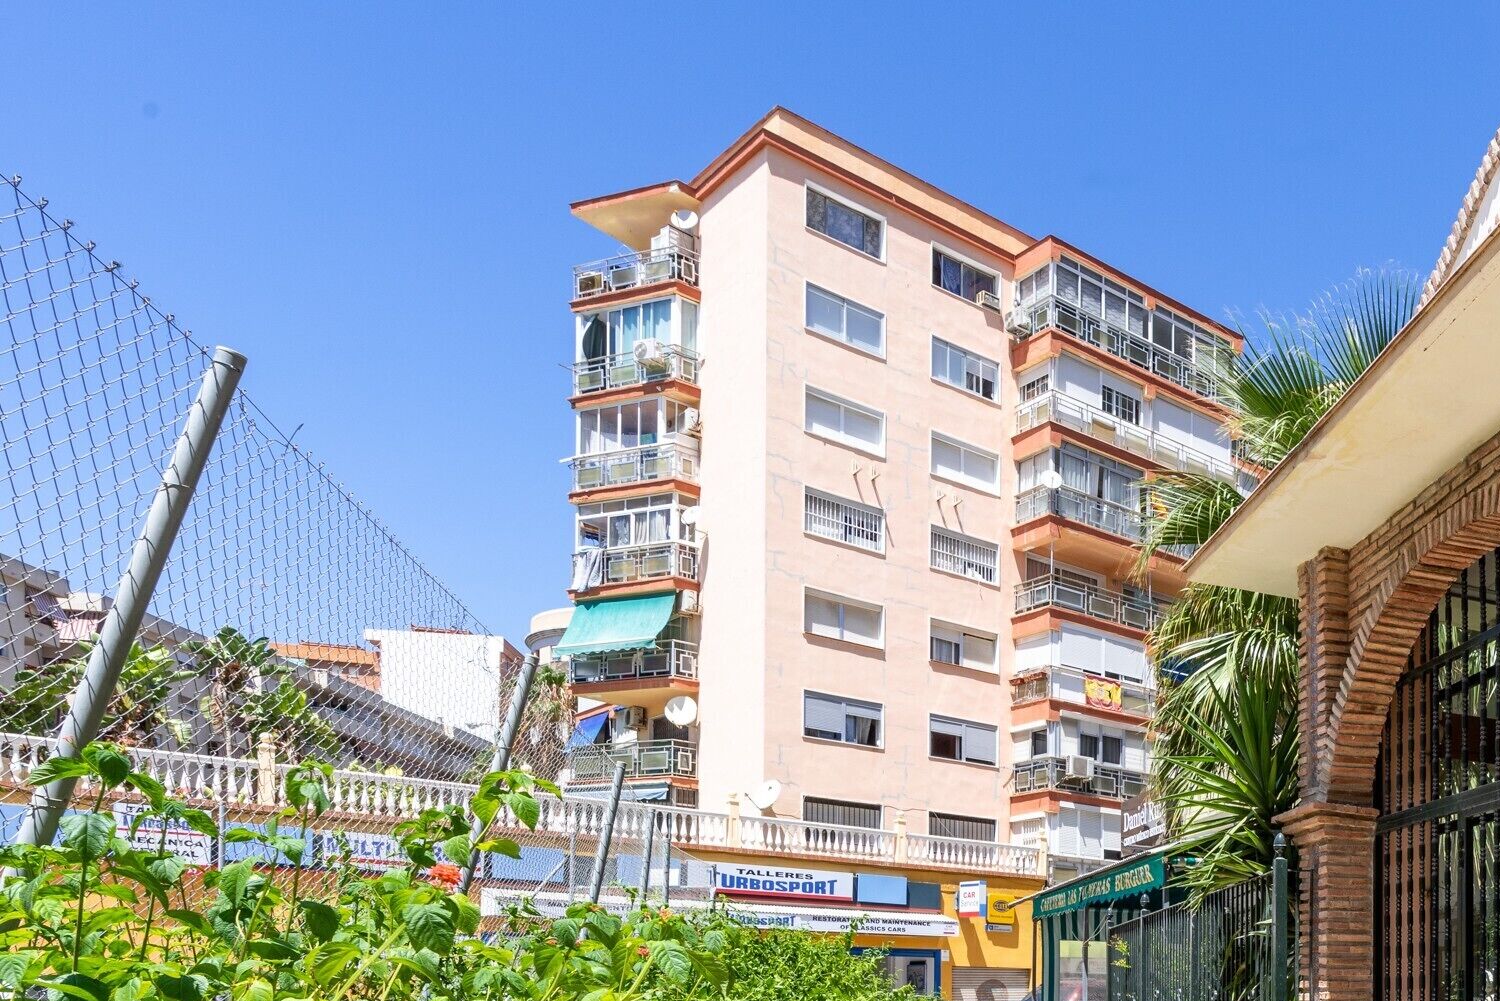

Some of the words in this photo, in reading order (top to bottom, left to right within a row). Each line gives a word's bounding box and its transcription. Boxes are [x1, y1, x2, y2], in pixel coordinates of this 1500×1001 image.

[1123, 802, 1147, 832] Daniel
[736, 868, 813, 880] TALLERES
[1114, 863, 1155, 892] BURGUER
[963, 891, 976, 899] CAR
[882, 918, 931, 927] MAINTENANCE
